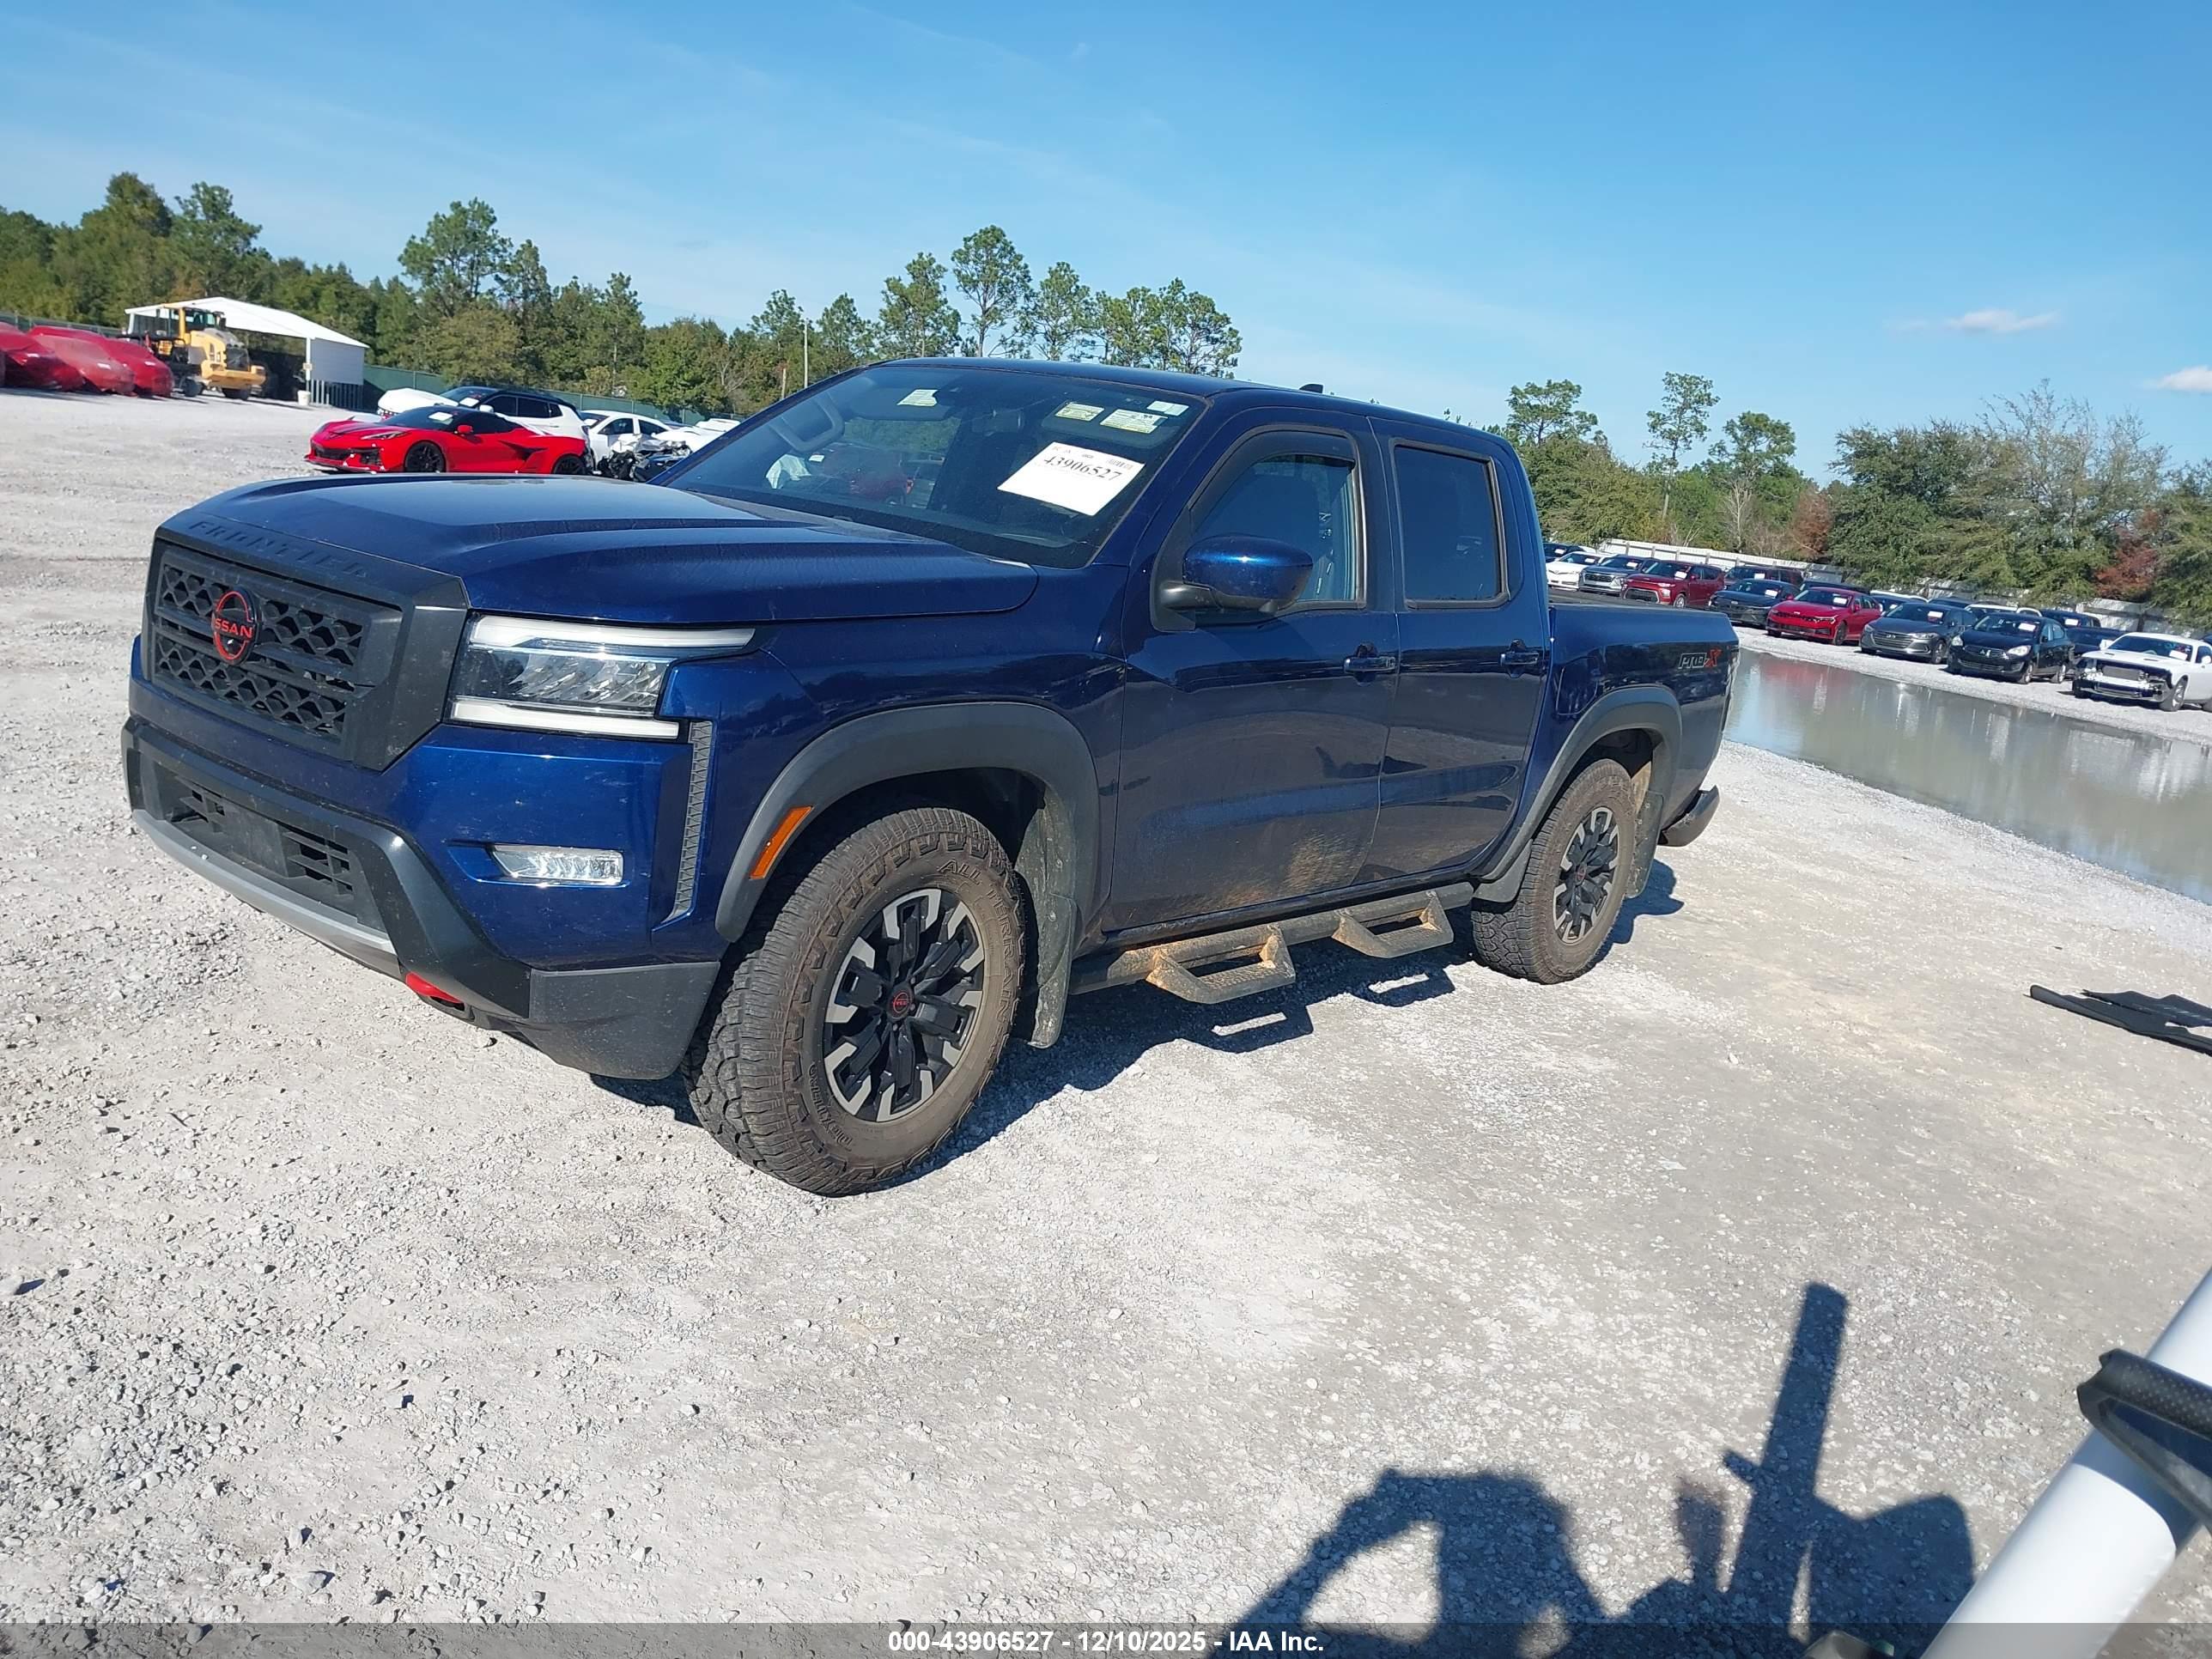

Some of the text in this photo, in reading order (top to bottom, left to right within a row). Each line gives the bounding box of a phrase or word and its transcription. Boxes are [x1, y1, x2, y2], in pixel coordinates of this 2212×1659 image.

[1043, 455, 1122, 481] 43906527
[214, 617, 253, 639] SSAN
[937, 860, 981, 885] ALL
